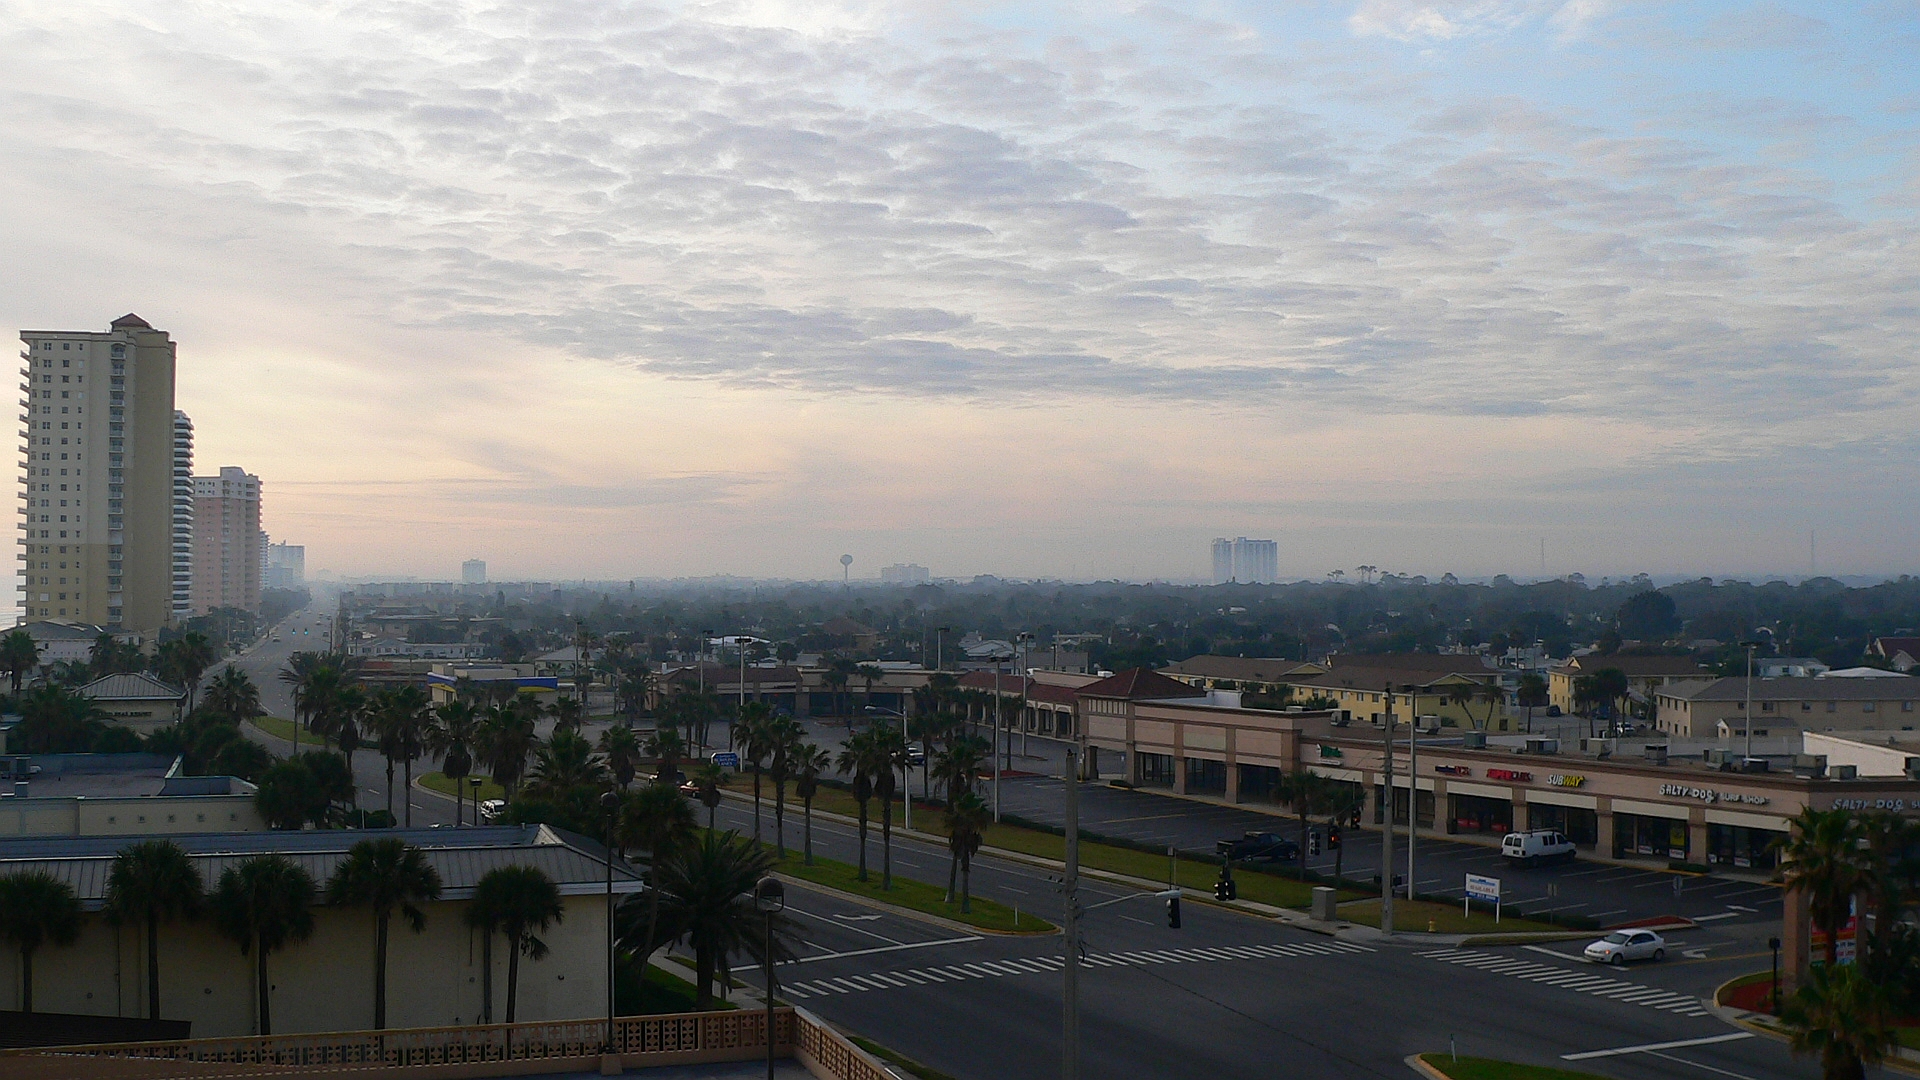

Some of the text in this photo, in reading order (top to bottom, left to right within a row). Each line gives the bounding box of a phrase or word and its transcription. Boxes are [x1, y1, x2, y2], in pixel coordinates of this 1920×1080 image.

[1547, 774, 1584, 787] SUBWAY
[1658, 783, 1766, 805] SALTY DOG SURF SHOP
[1831, 798, 1869, 810] SALTY
[1875, 798, 1904, 813] DOG
